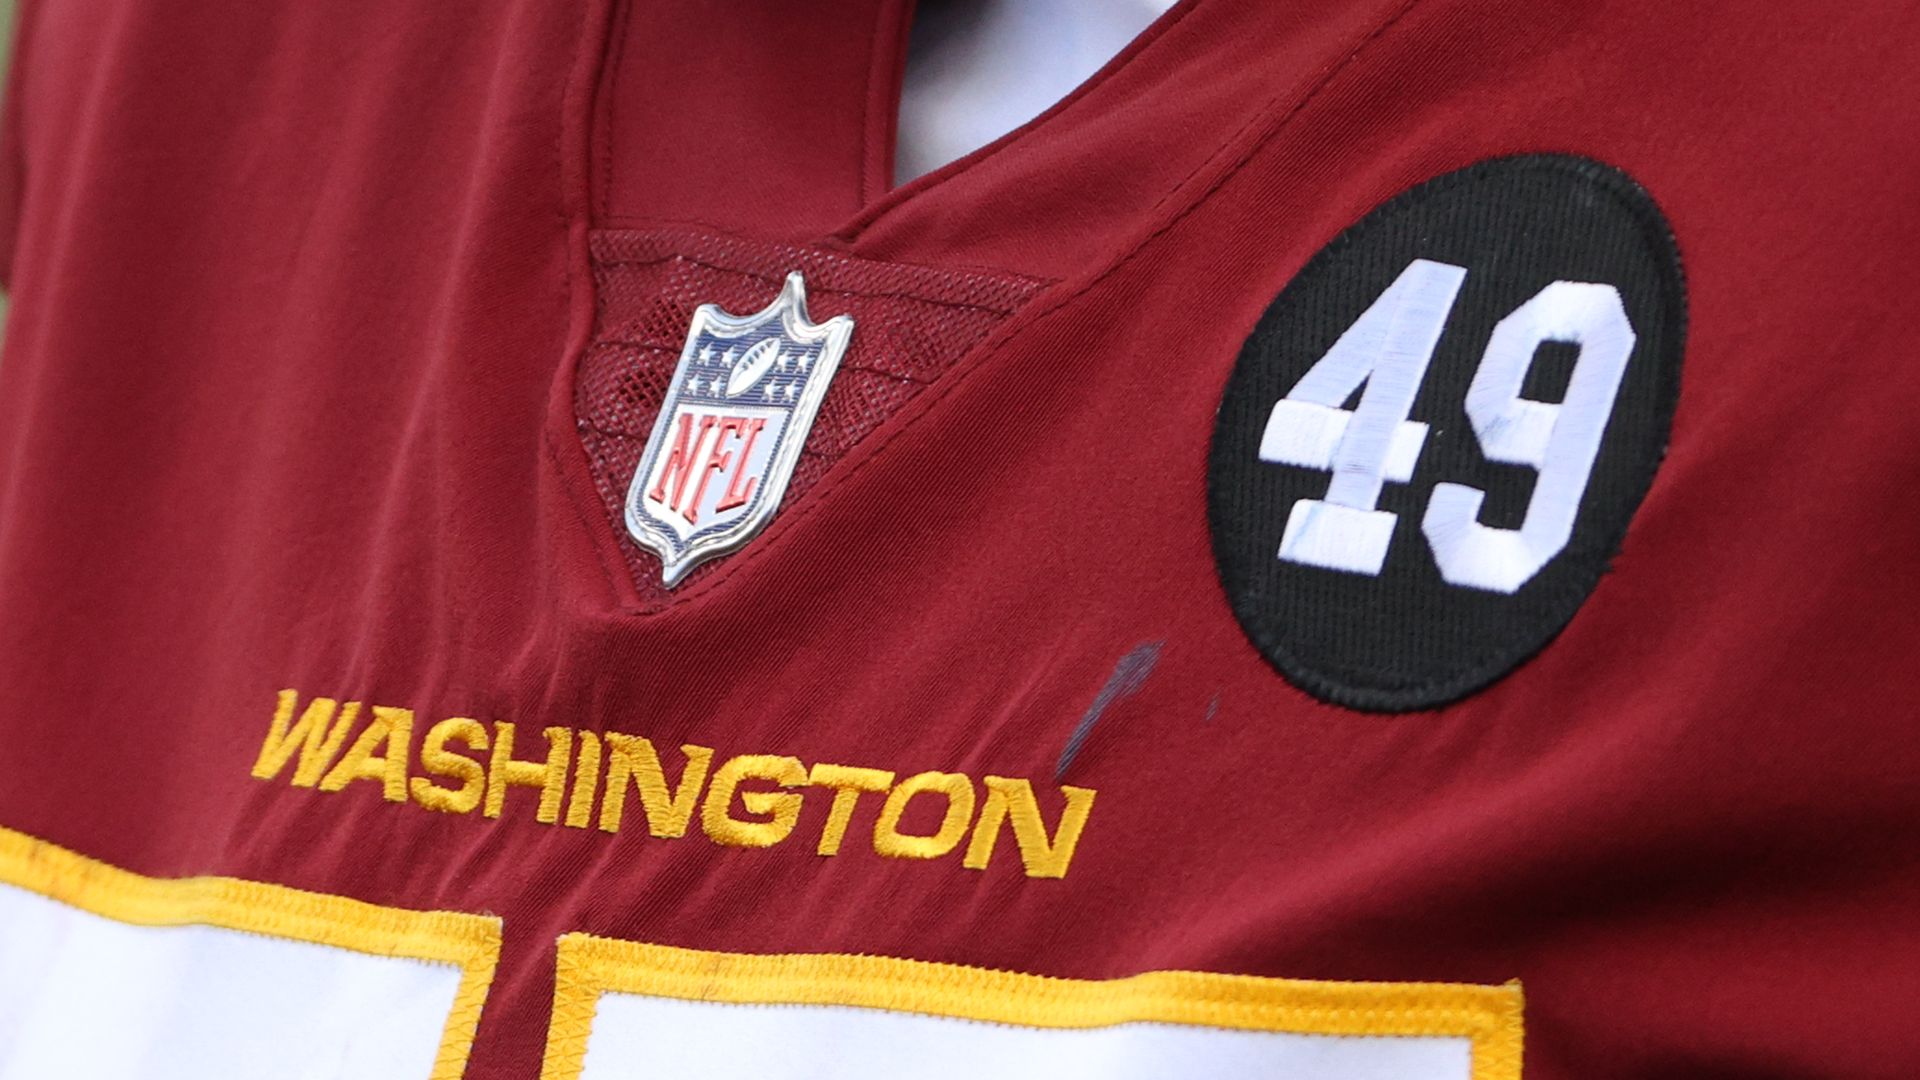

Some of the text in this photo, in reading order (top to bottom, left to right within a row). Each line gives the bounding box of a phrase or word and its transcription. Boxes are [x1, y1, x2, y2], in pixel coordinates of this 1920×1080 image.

[649, 412, 767, 525] NFL
[1259, 258, 1637, 594] 49
[252, 688, 1096, 880] WASHINGTON
